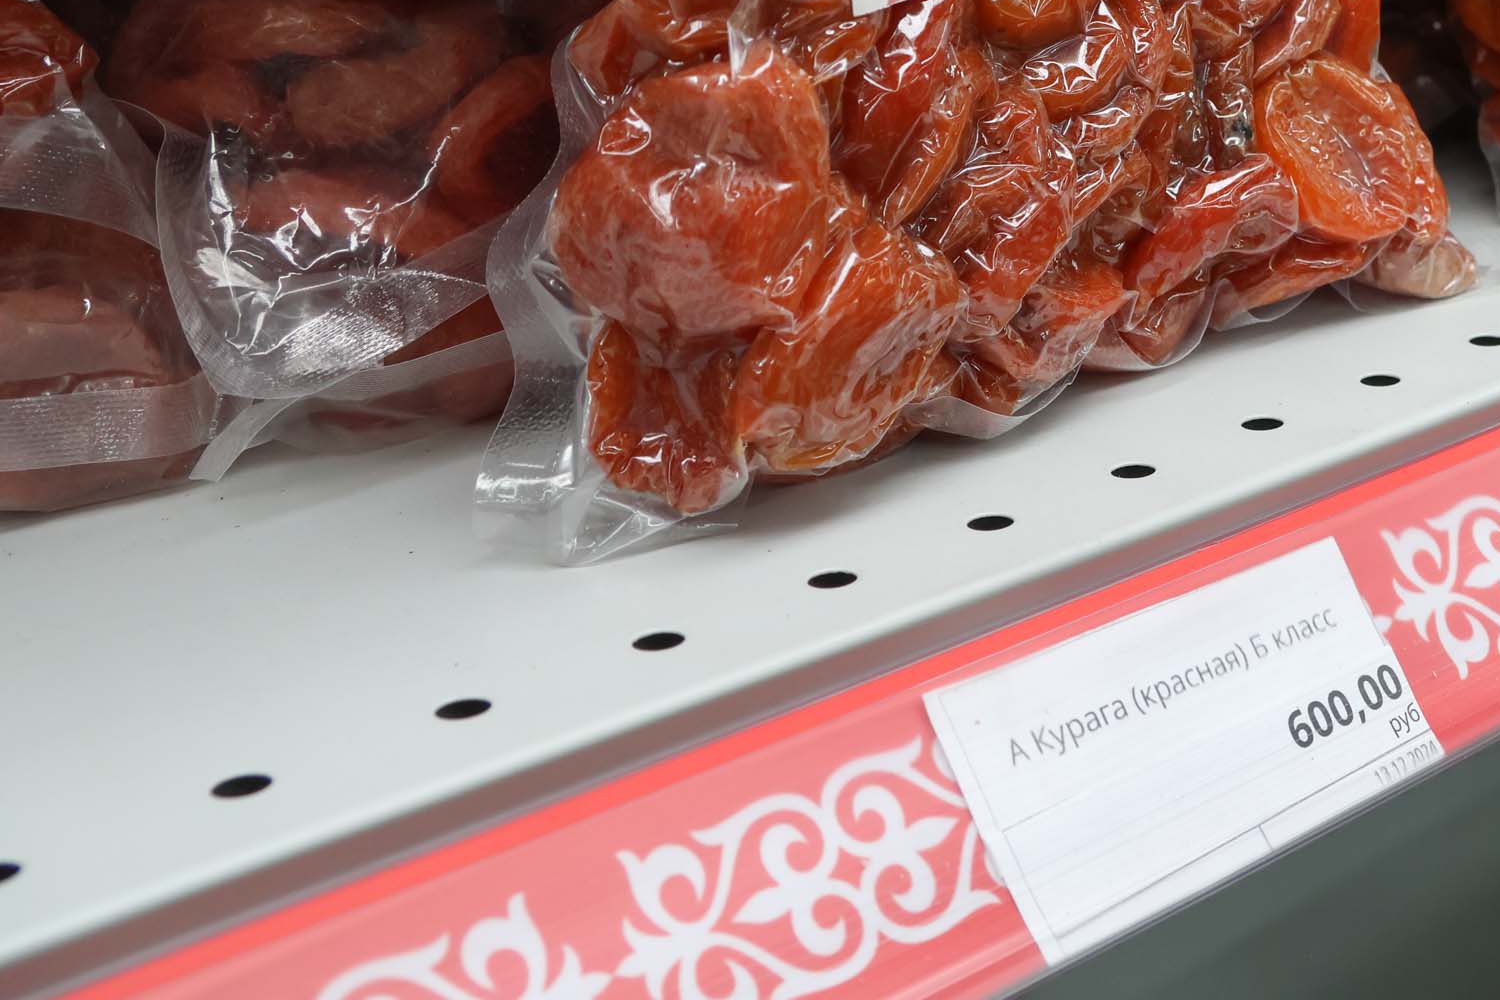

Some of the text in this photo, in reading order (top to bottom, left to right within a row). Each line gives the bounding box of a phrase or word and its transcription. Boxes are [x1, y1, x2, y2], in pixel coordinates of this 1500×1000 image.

[1030, 698, 1129, 756] Курага
[1131, 642, 1250, 715] (красная)
[1249, 633, 1269, 660] Б
[1271, 608, 1338, 651] класс
[1287, 664, 1403, 749] 600,00
[1388, 702, 1421, 739] руб
